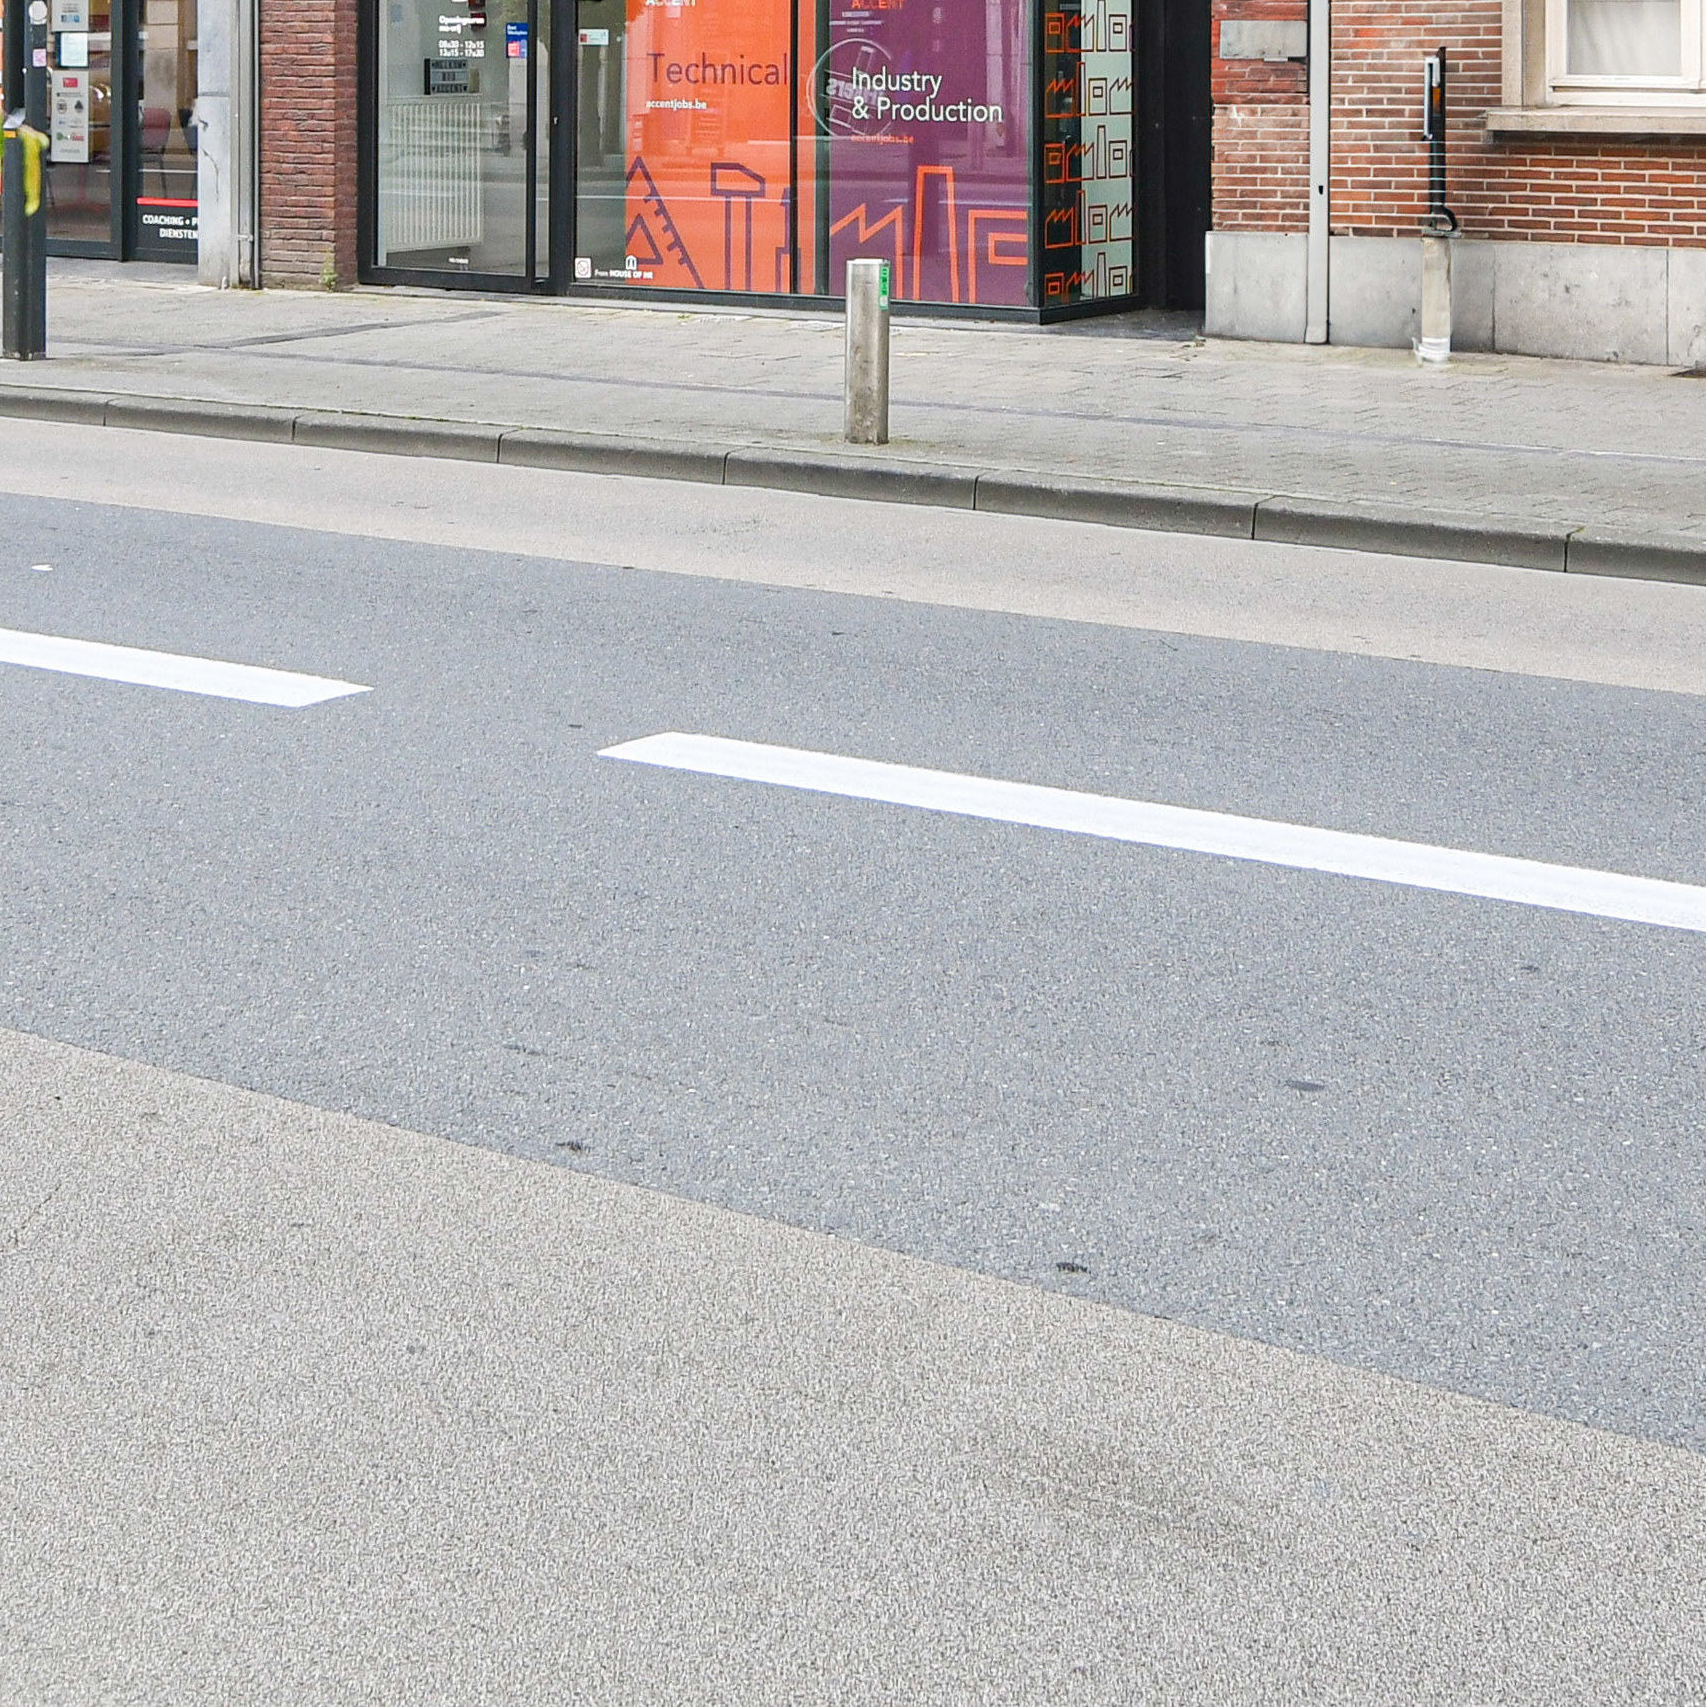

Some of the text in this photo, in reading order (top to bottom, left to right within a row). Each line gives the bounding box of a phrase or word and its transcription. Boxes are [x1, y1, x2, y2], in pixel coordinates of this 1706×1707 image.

[646, 52, 788, 85] Technical
[852, 66, 942, 98] Industry
[646, 99, 708, 111] accentjobs.be
[852, 96, 1003, 122] & Production
[142, 214, 185, 226] COACHING
